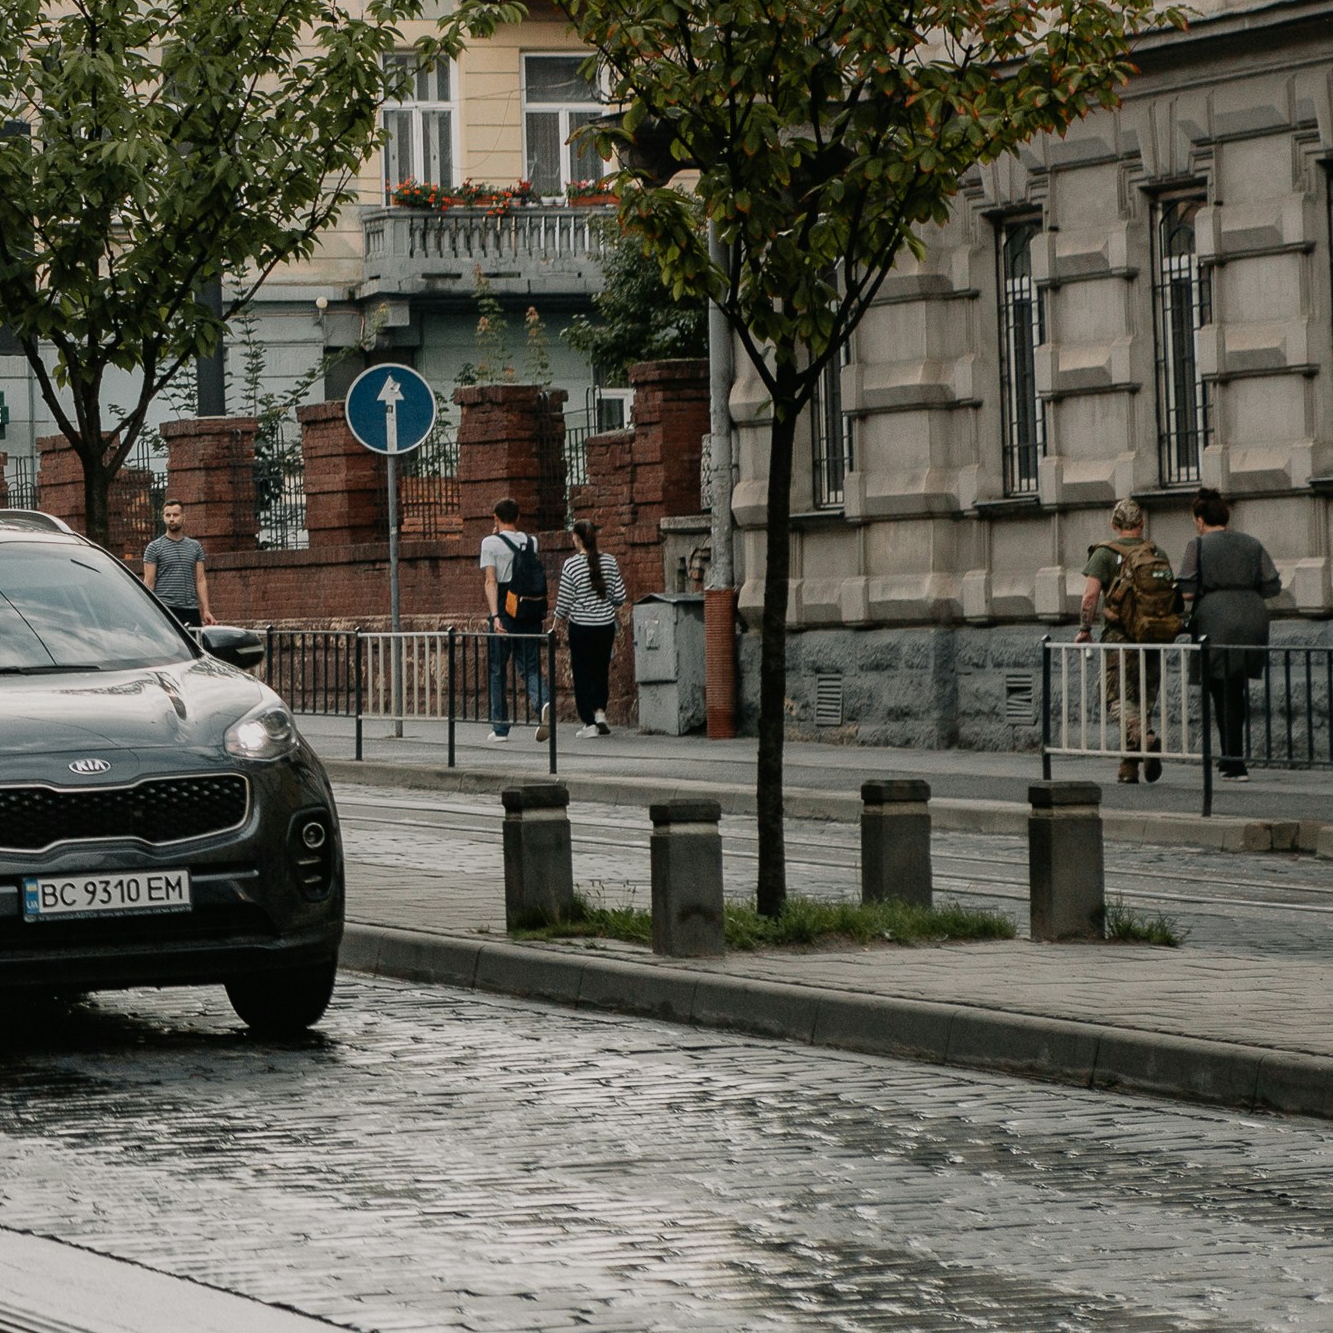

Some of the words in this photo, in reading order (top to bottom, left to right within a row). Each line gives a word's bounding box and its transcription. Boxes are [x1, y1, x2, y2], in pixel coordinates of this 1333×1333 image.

[75, 758, 106, 772] KIA
[41, 882, 77, 908] BC
[83, 878, 140, 906] 9310
[147, 875, 183, 901] EM
